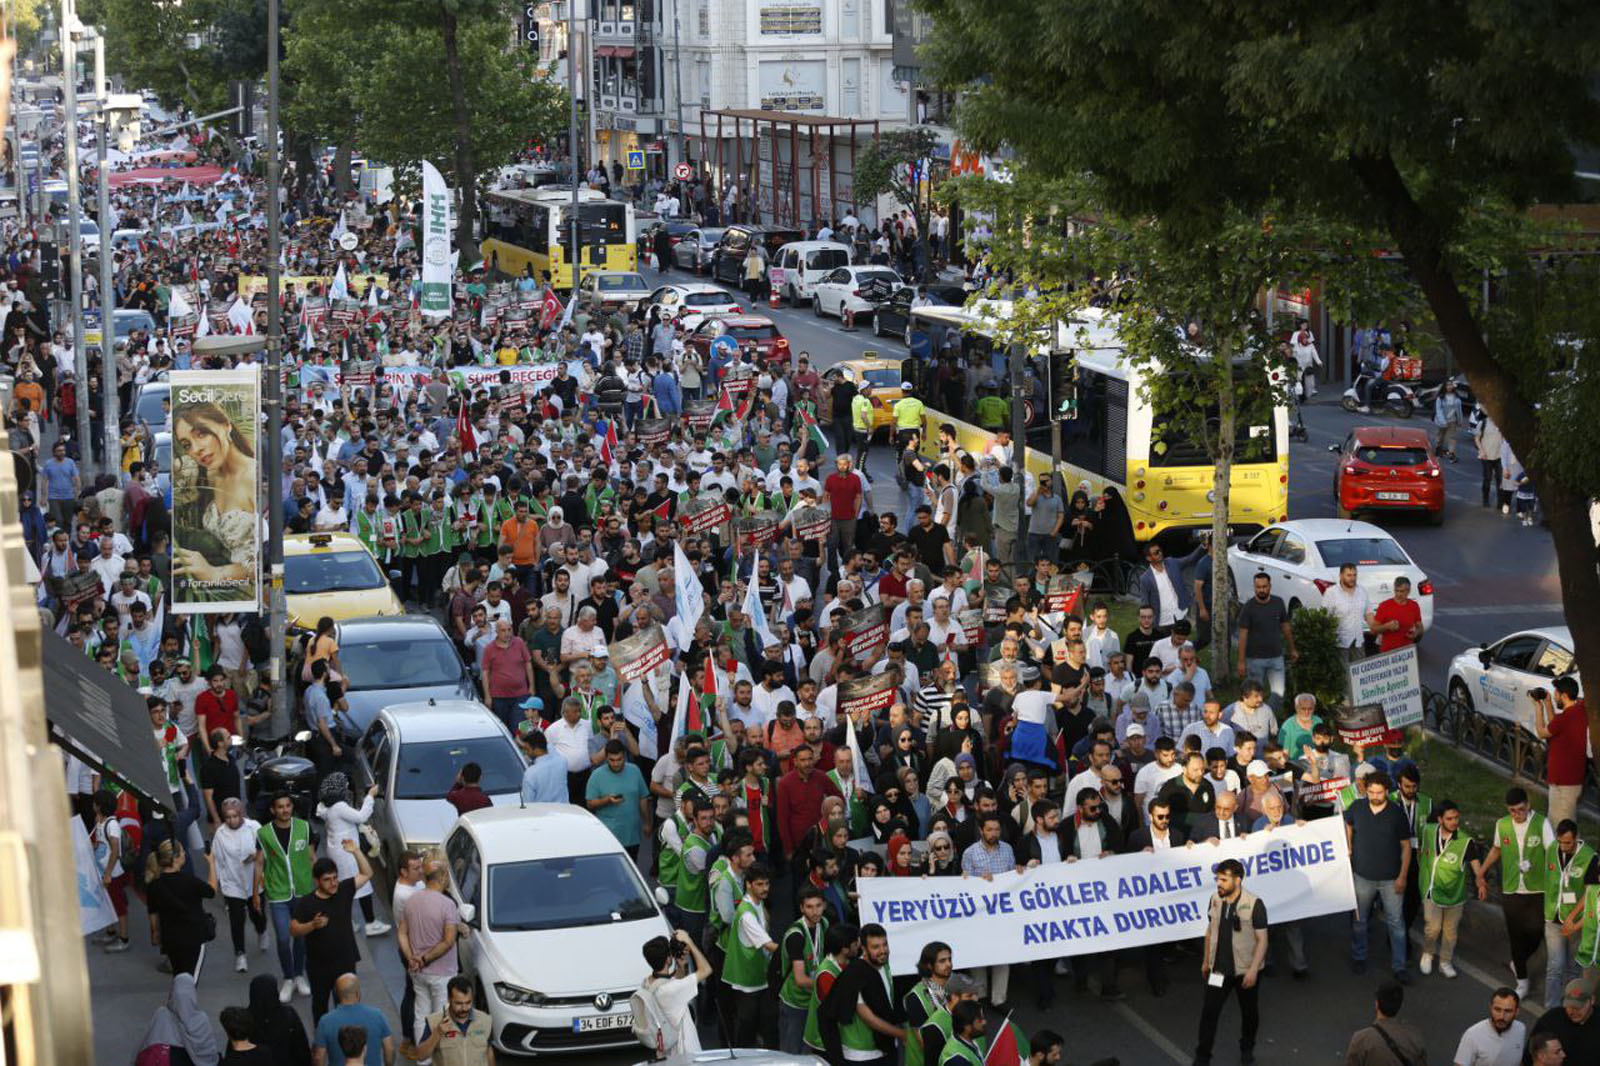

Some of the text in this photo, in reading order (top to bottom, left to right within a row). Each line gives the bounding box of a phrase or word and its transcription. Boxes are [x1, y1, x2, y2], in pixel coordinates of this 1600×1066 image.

[873, 841, 1336, 923] YERYÜZÜ VE GÖKLER ADALET YESİNDE
[1023, 901, 1201, 945] AYAKTA DURUR!
[580, 1019, 592, 1030] 34
